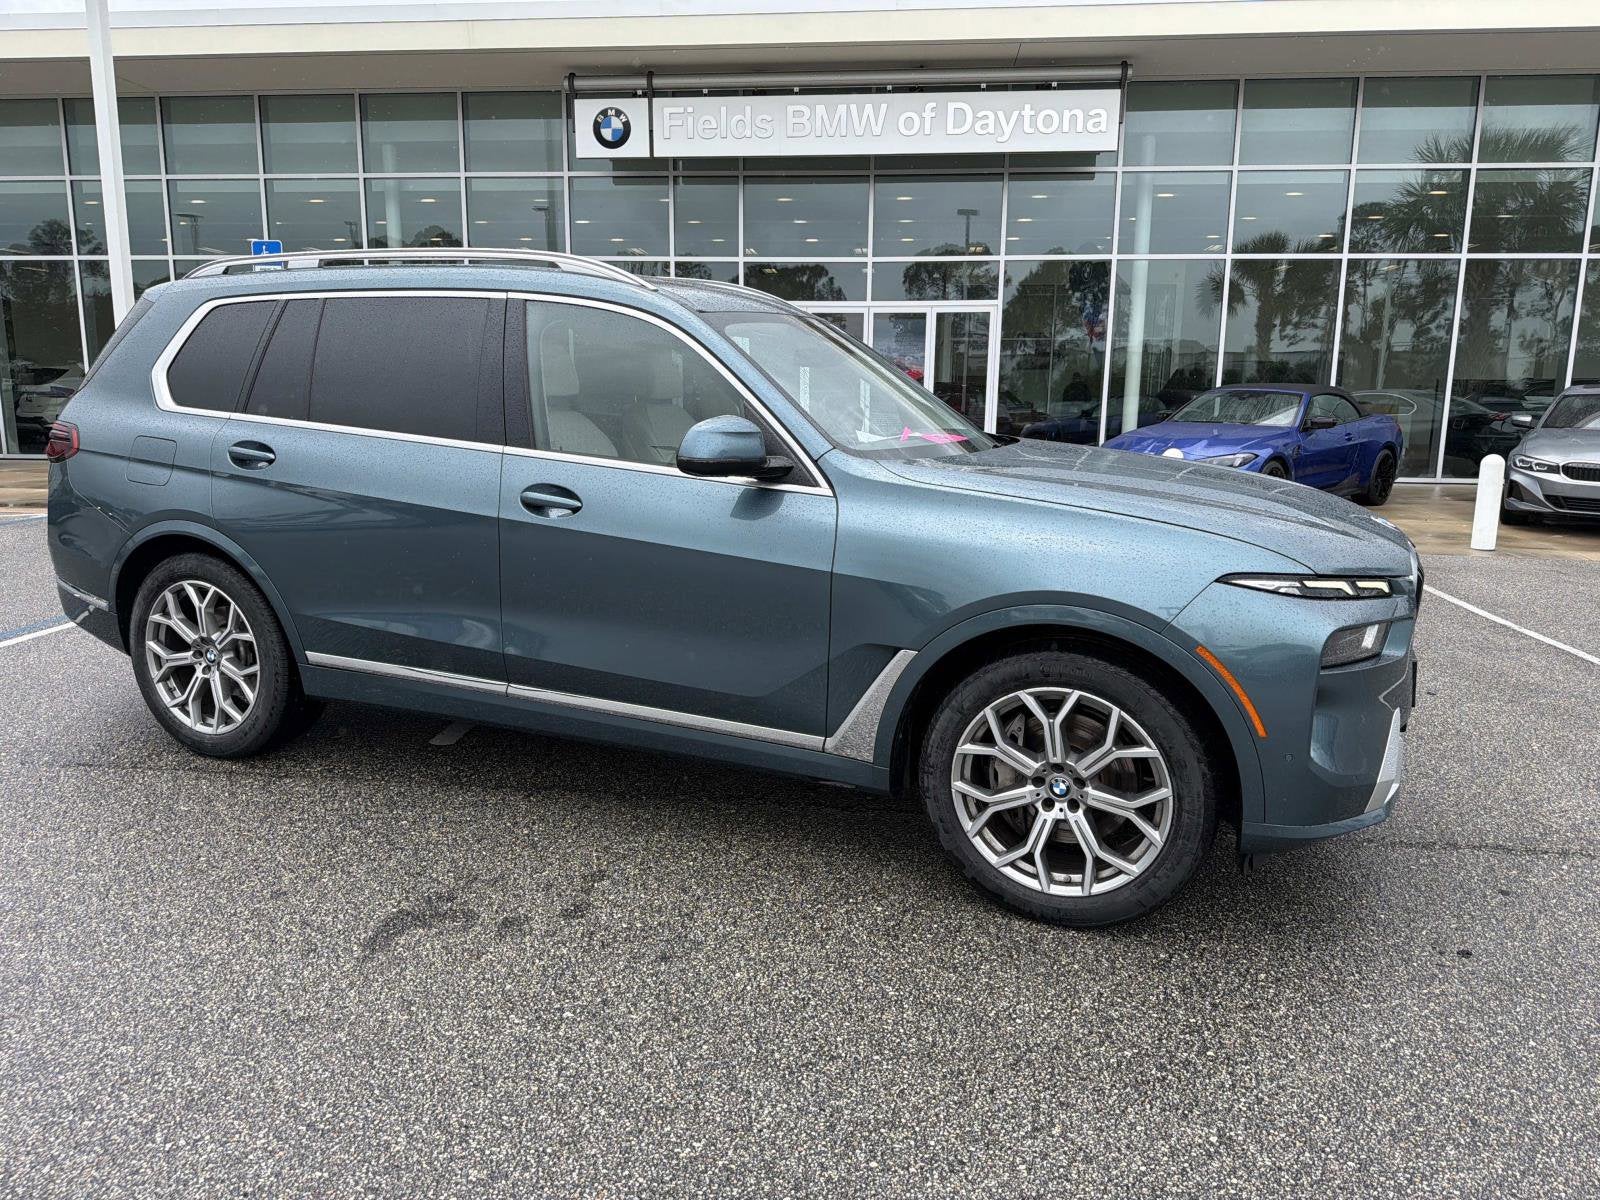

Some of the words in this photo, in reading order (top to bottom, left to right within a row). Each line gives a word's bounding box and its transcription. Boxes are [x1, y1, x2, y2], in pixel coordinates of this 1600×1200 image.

[596, 109, 627, 122] BMW
[662, 105, 775, 140] Fields
[785, 103, 888, 139] BMW
[897, 101, 937, 137] of
[945, 101, 1108, 144] Daytona
